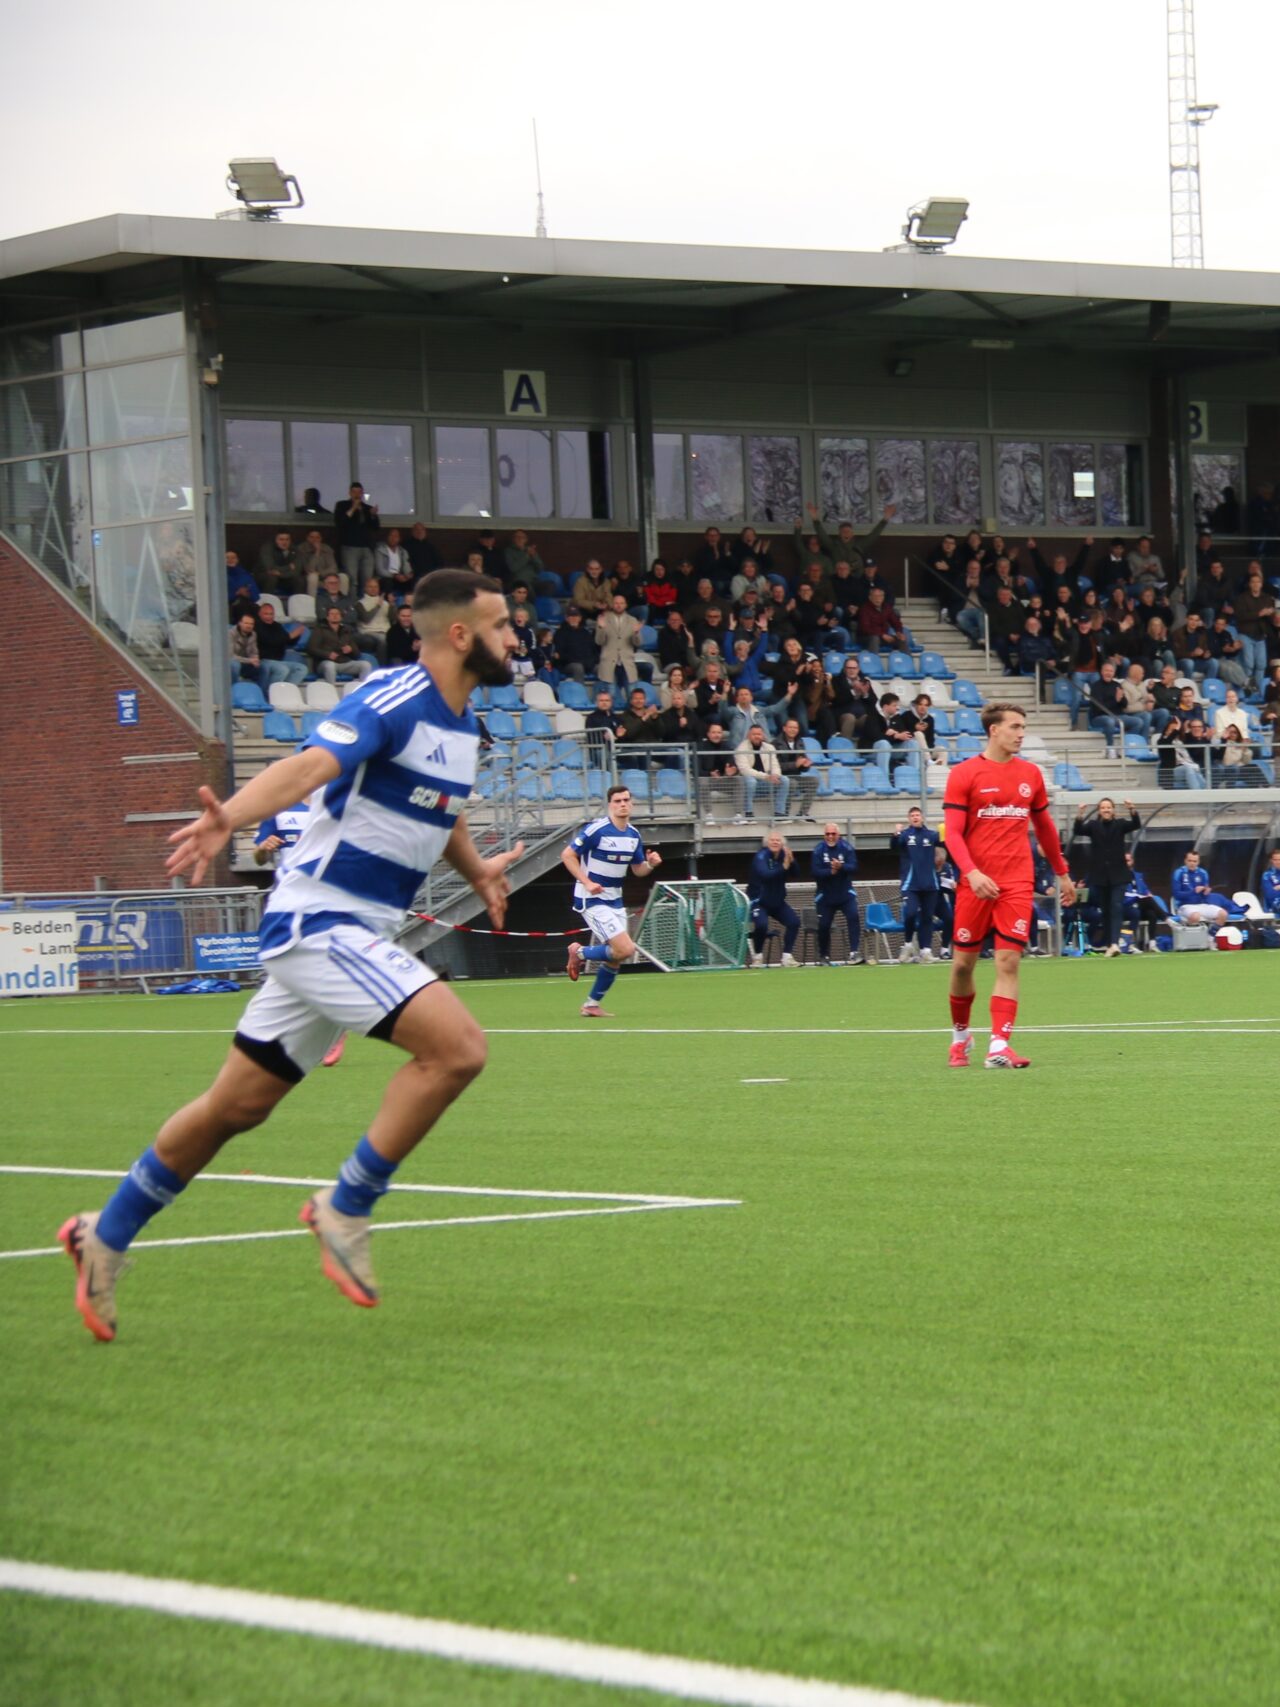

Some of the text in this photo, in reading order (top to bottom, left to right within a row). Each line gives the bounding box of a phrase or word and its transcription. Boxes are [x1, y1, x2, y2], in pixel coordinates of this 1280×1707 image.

[510, 373, 542, 413] A
[13, 920, 73, 935] Bedden
[0, 961, 78, 990] ndalf
